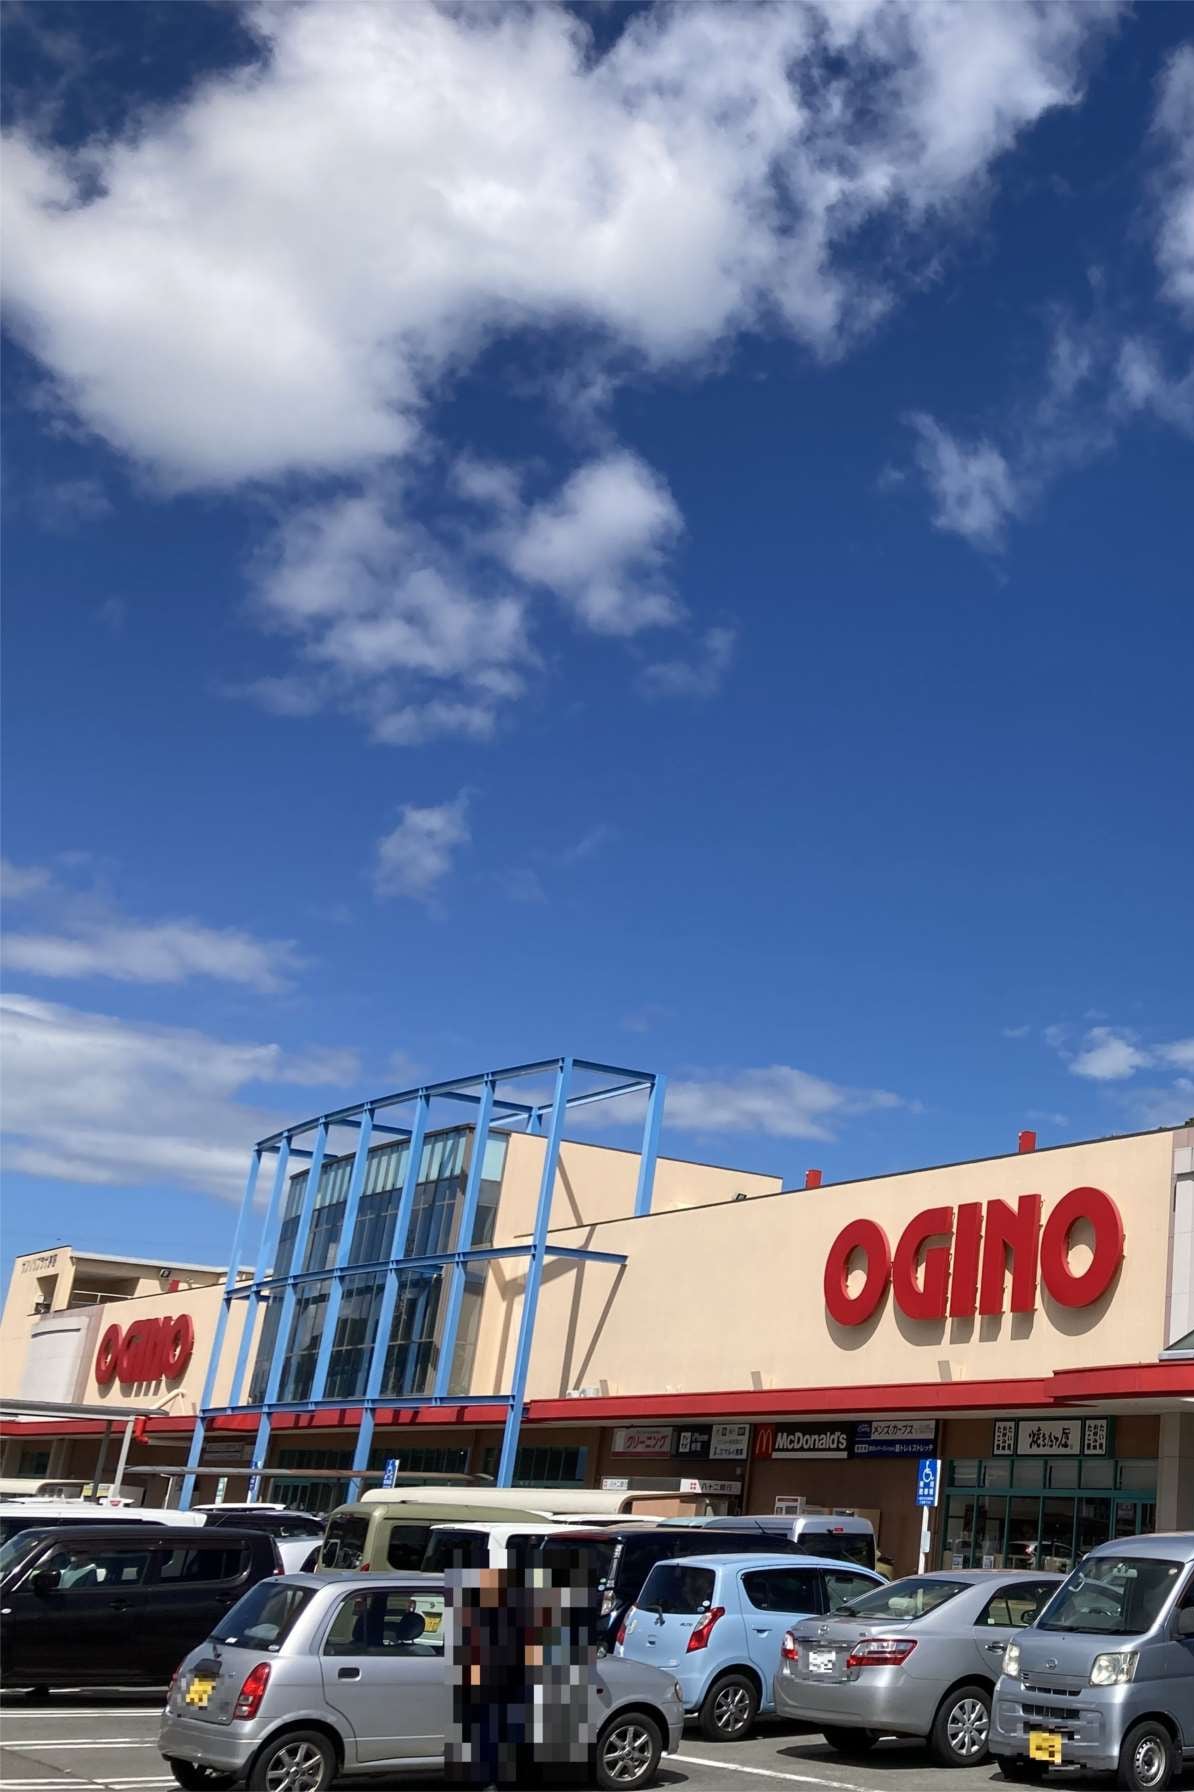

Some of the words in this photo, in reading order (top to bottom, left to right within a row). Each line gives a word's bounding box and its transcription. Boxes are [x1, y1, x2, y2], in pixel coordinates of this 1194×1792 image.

[823, 1186, 1125, 1327] OGINO
[95, 1314, 195, 1386] OGINO
[624, 1434, 670, 1449] クリーニング
[775, 1431, 848, 1450] McDonald's
